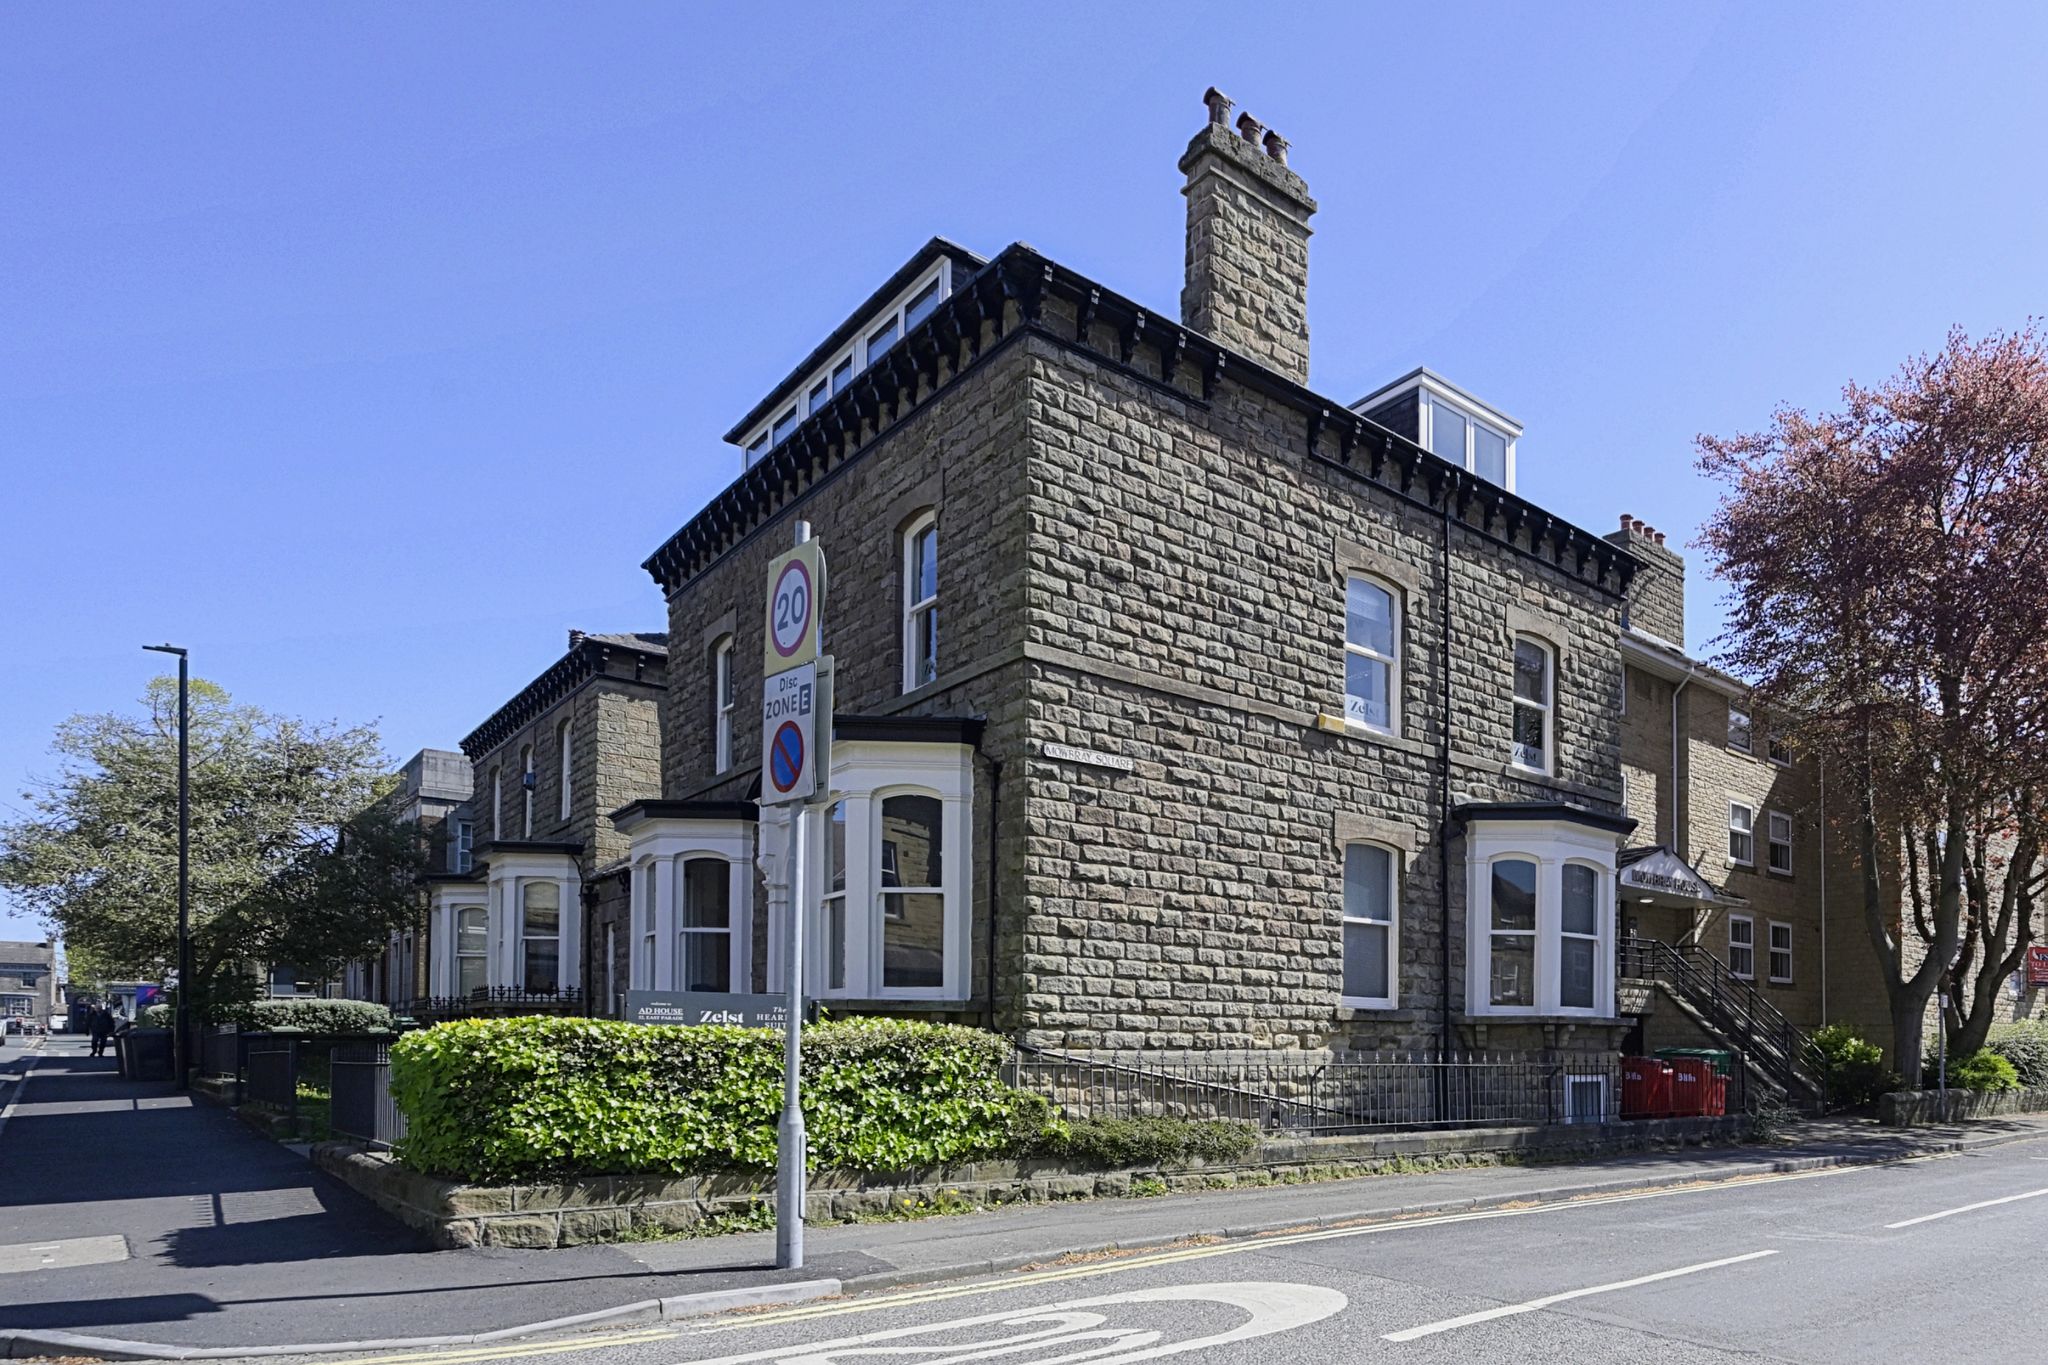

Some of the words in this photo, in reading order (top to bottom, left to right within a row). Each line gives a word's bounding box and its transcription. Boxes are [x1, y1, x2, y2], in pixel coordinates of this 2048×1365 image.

[777, 584, 805, 632] 20
[780, 676, 798, 692] Disc
[766, 694, 797, 720] ZONE
[1045, 745, 1091, 761] MOWBRAY
[1096, 754, 1131, 769] SQUARE
[1674, 878, 1702, 893] HOUSE
[638, 1007, 652, 1015] AD
[654, 1007, 684, 1015] HOUSE
[700, 1010, 744, 1023] Zelst
